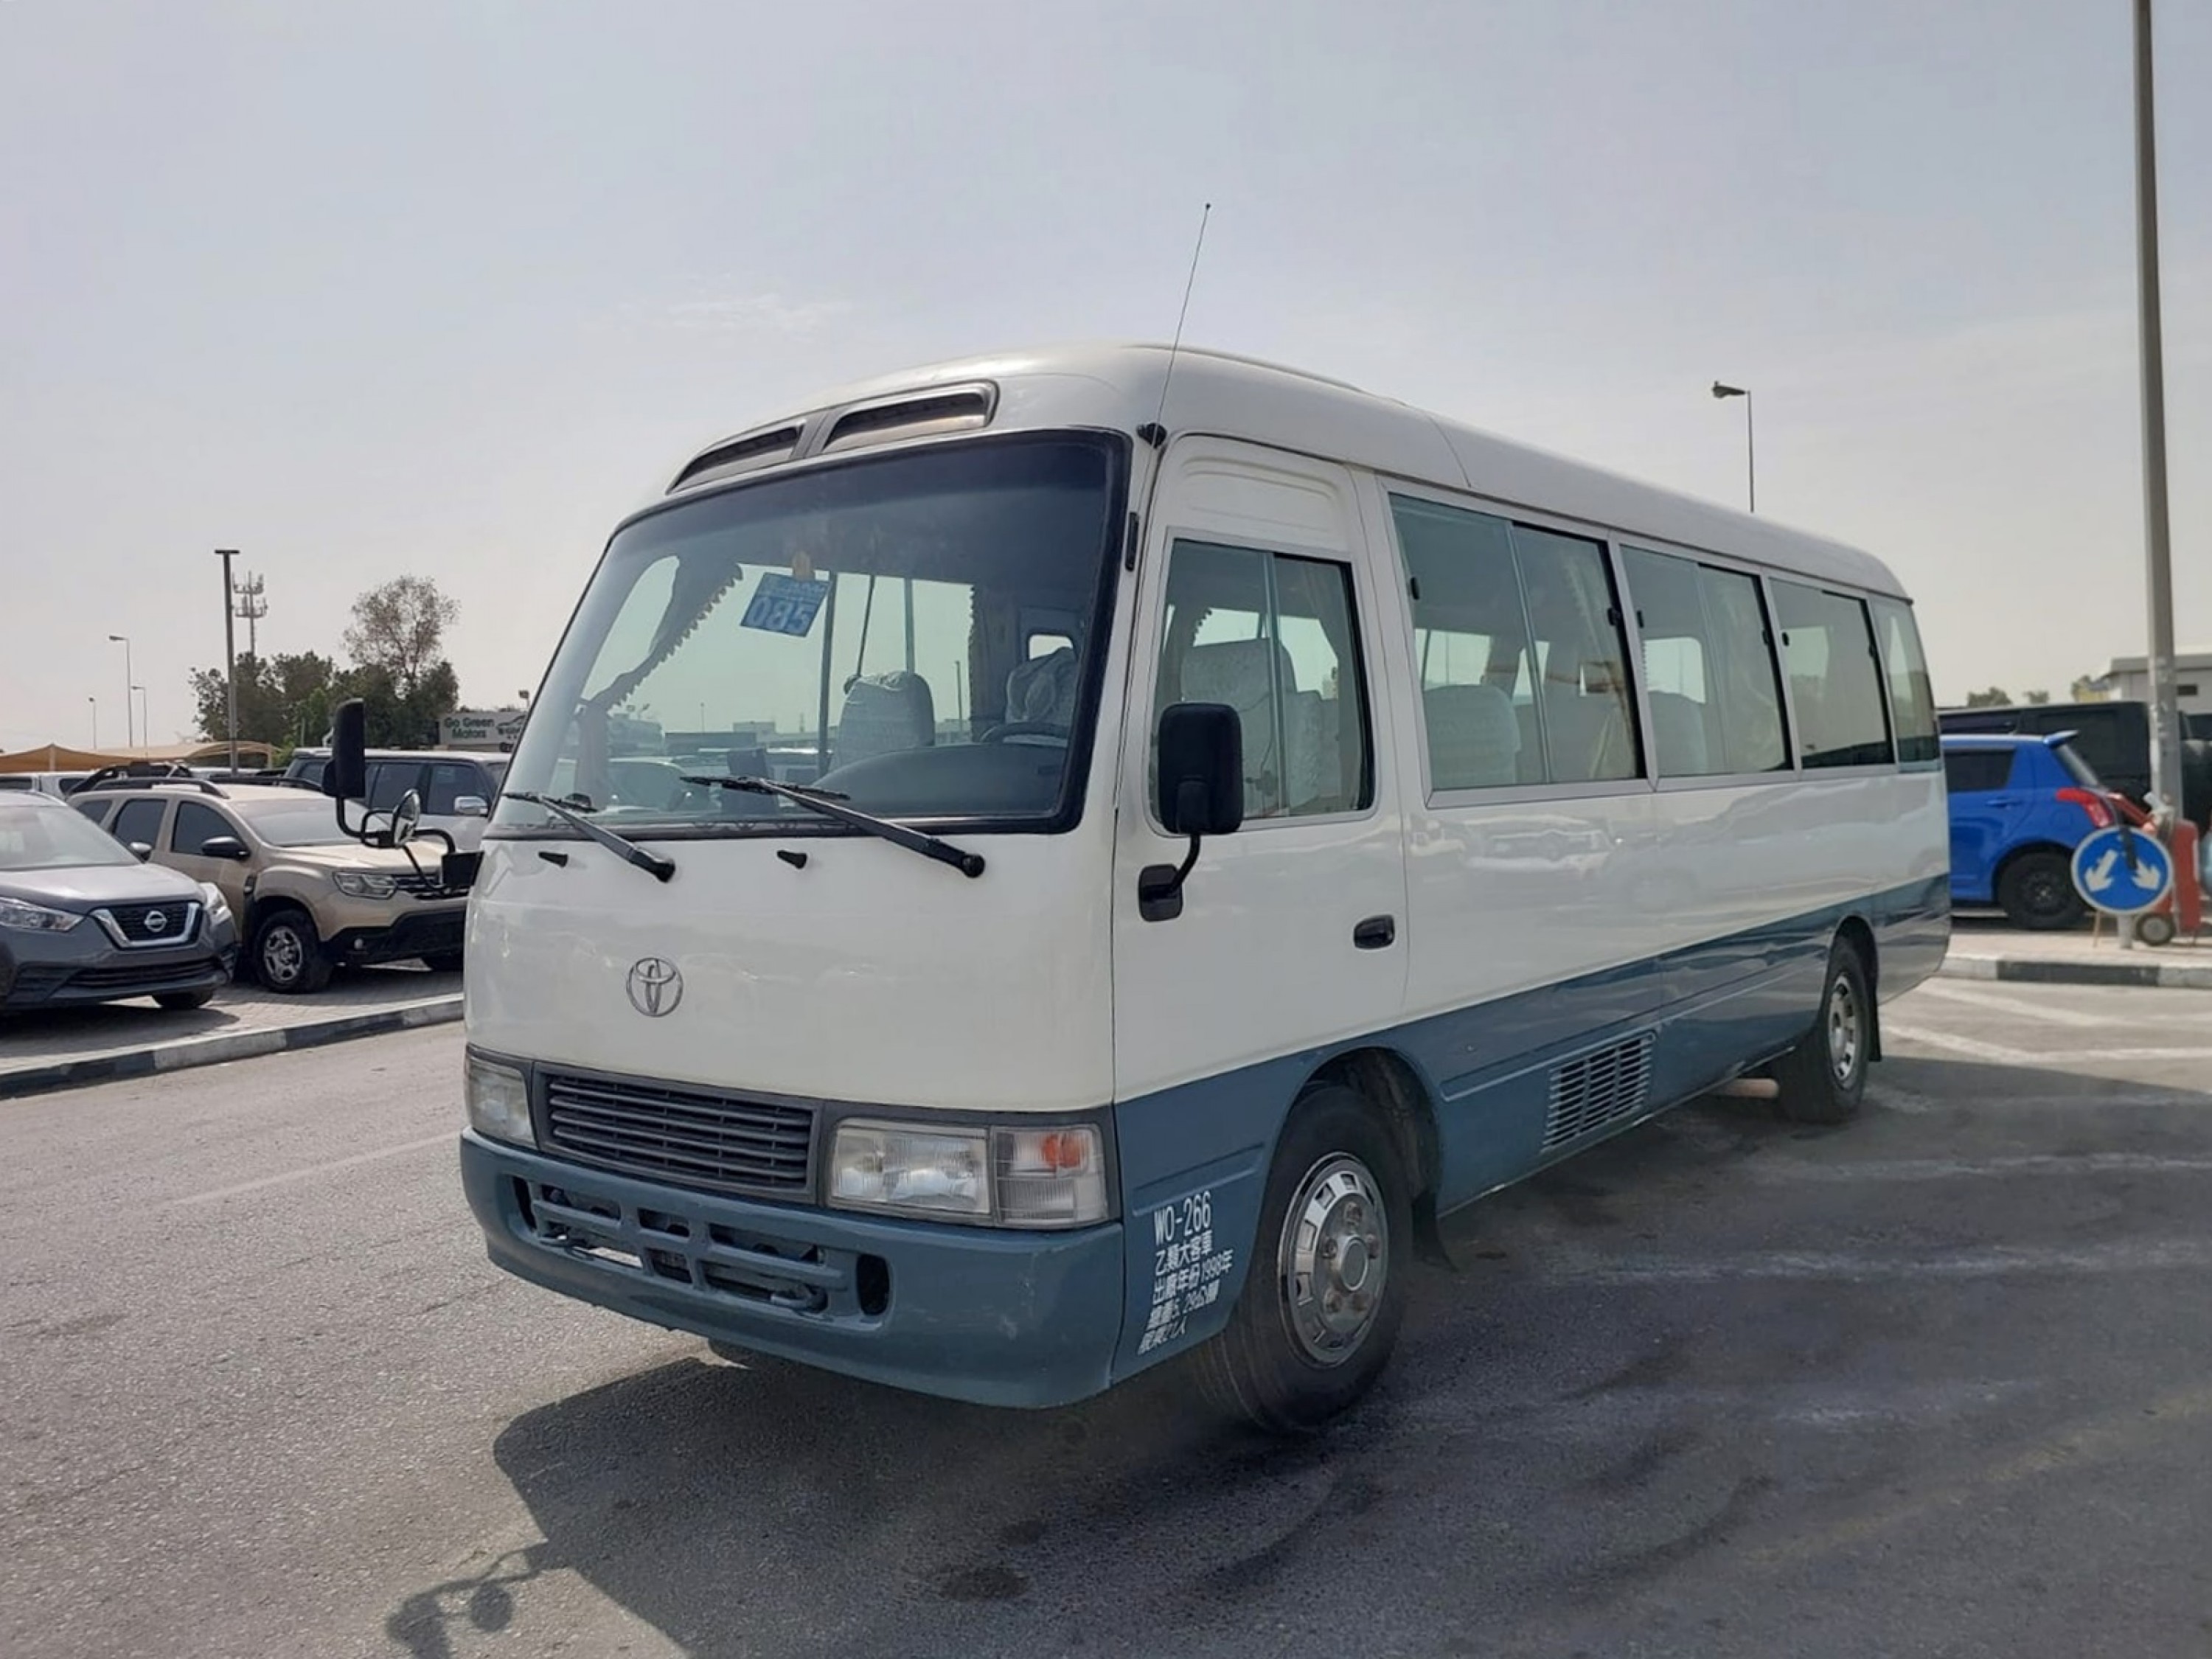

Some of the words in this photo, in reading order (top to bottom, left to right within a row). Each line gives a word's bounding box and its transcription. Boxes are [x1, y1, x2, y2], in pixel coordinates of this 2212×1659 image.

[444, 717, 460, 728] Go
[462, 717, 495, 728] Green
[1154, 1190, 1211, 1246] WO-266
